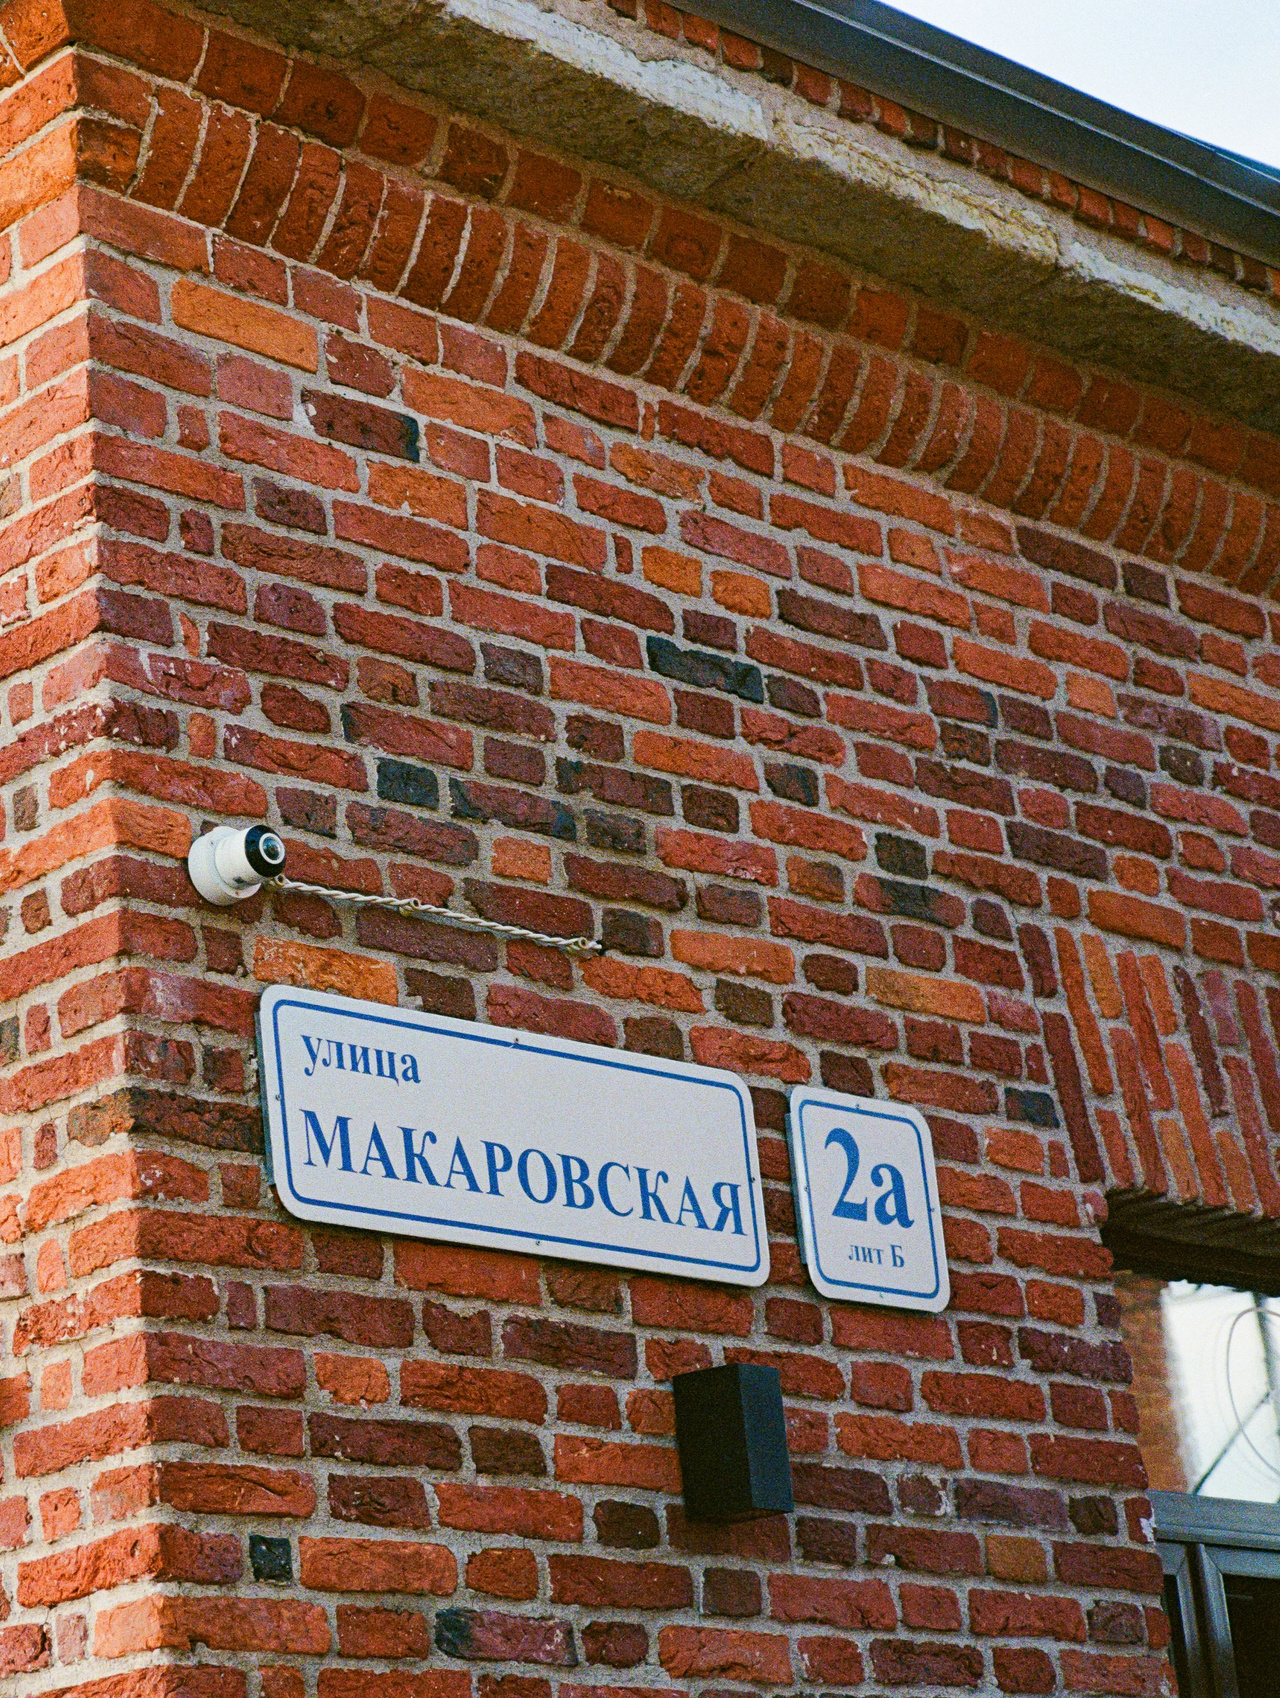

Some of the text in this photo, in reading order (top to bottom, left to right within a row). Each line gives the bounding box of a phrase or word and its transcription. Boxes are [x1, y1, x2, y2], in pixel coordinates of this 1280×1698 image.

[301, 1034, 422, 1084] улица
[300, 1109, 748, 1237] МАКАРОВСКАЯ
[824, 1127, 916, 1229] 2а
[848, 1244, 906, 1268] лит Б
